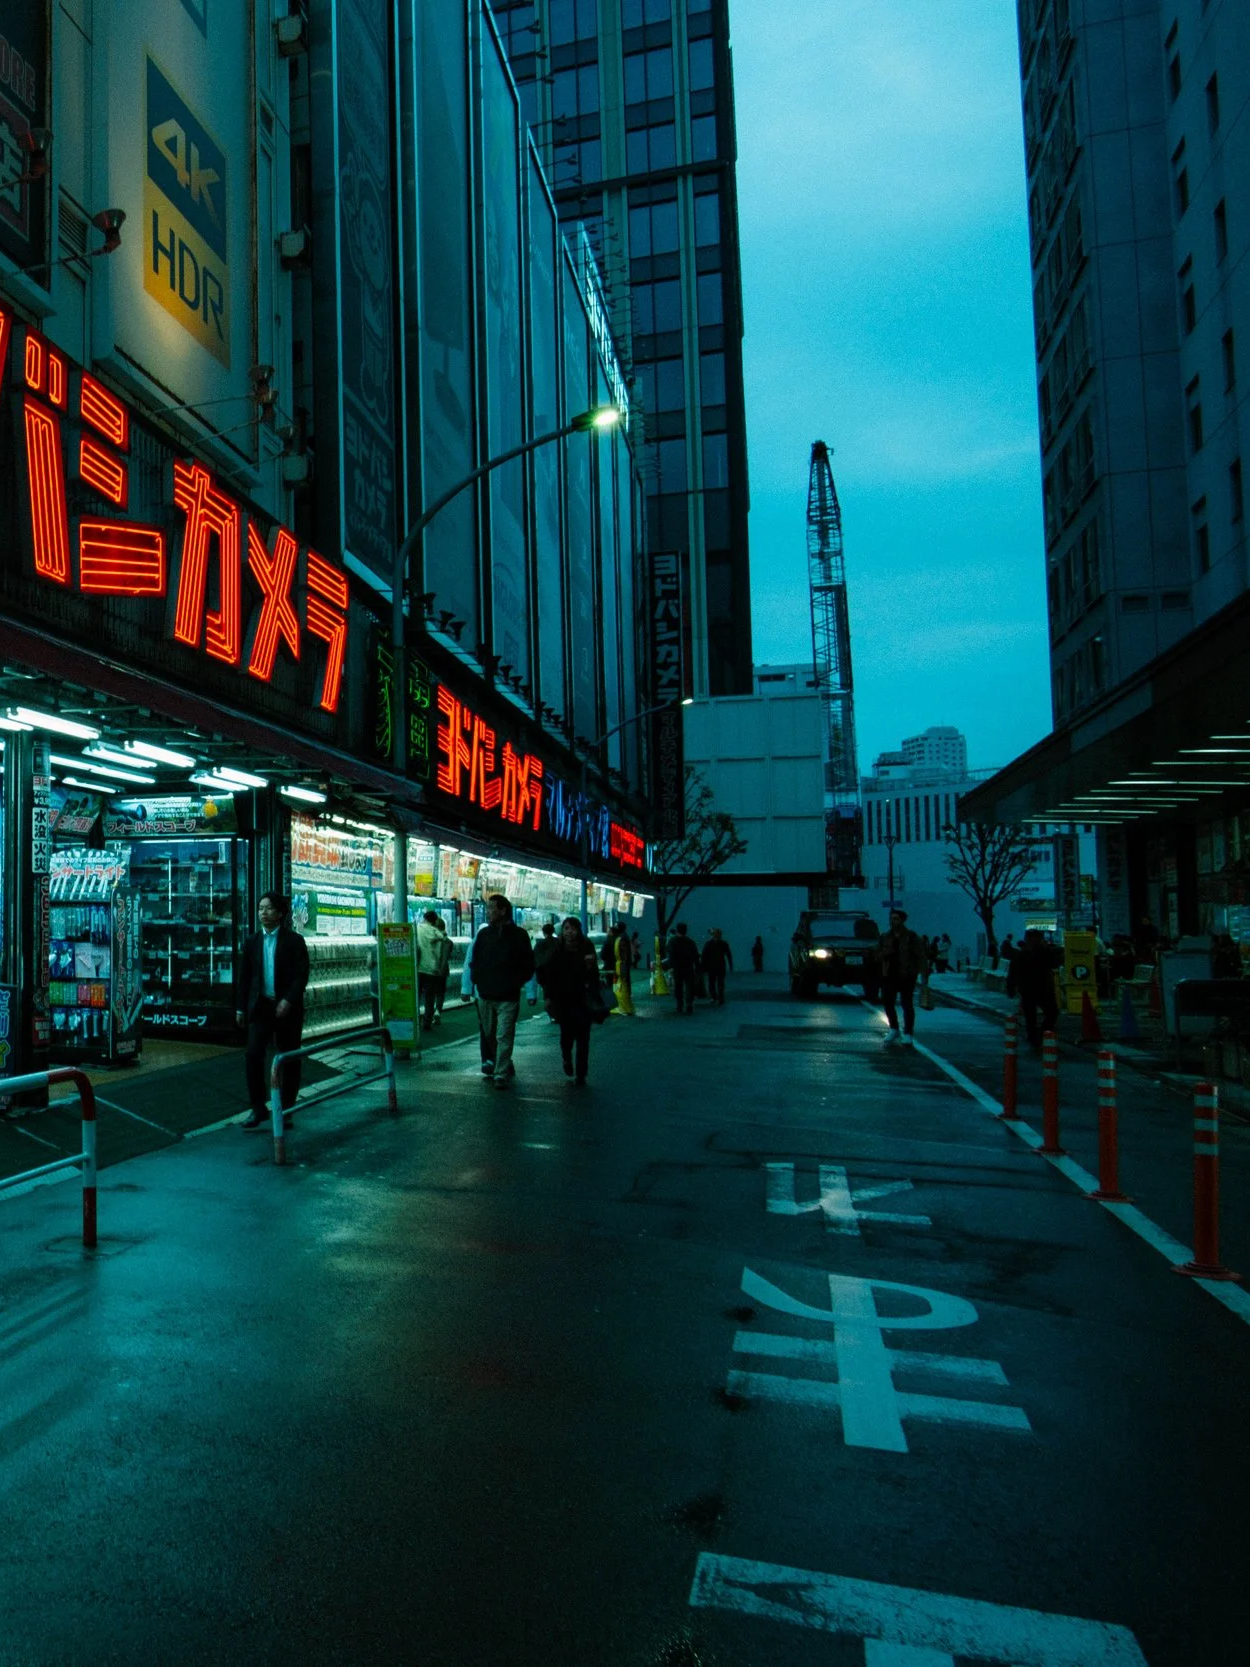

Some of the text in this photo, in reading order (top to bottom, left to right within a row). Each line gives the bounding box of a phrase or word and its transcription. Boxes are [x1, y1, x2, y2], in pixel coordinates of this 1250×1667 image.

[151, 116, 222, 230] 4K
[152, 209, 228, 343] HDR
[652, 553, 679, 703] ヨドバシカメラ
[437, 683, 544, 832] ヨドバシカメラ
[33, 808, 47, 840] 水没
[33, 842, 47, 872] 火災
[107, 819, 197, 833] フィールドスコープ
[141, 1012, 208, 1028] ールドスコープ
